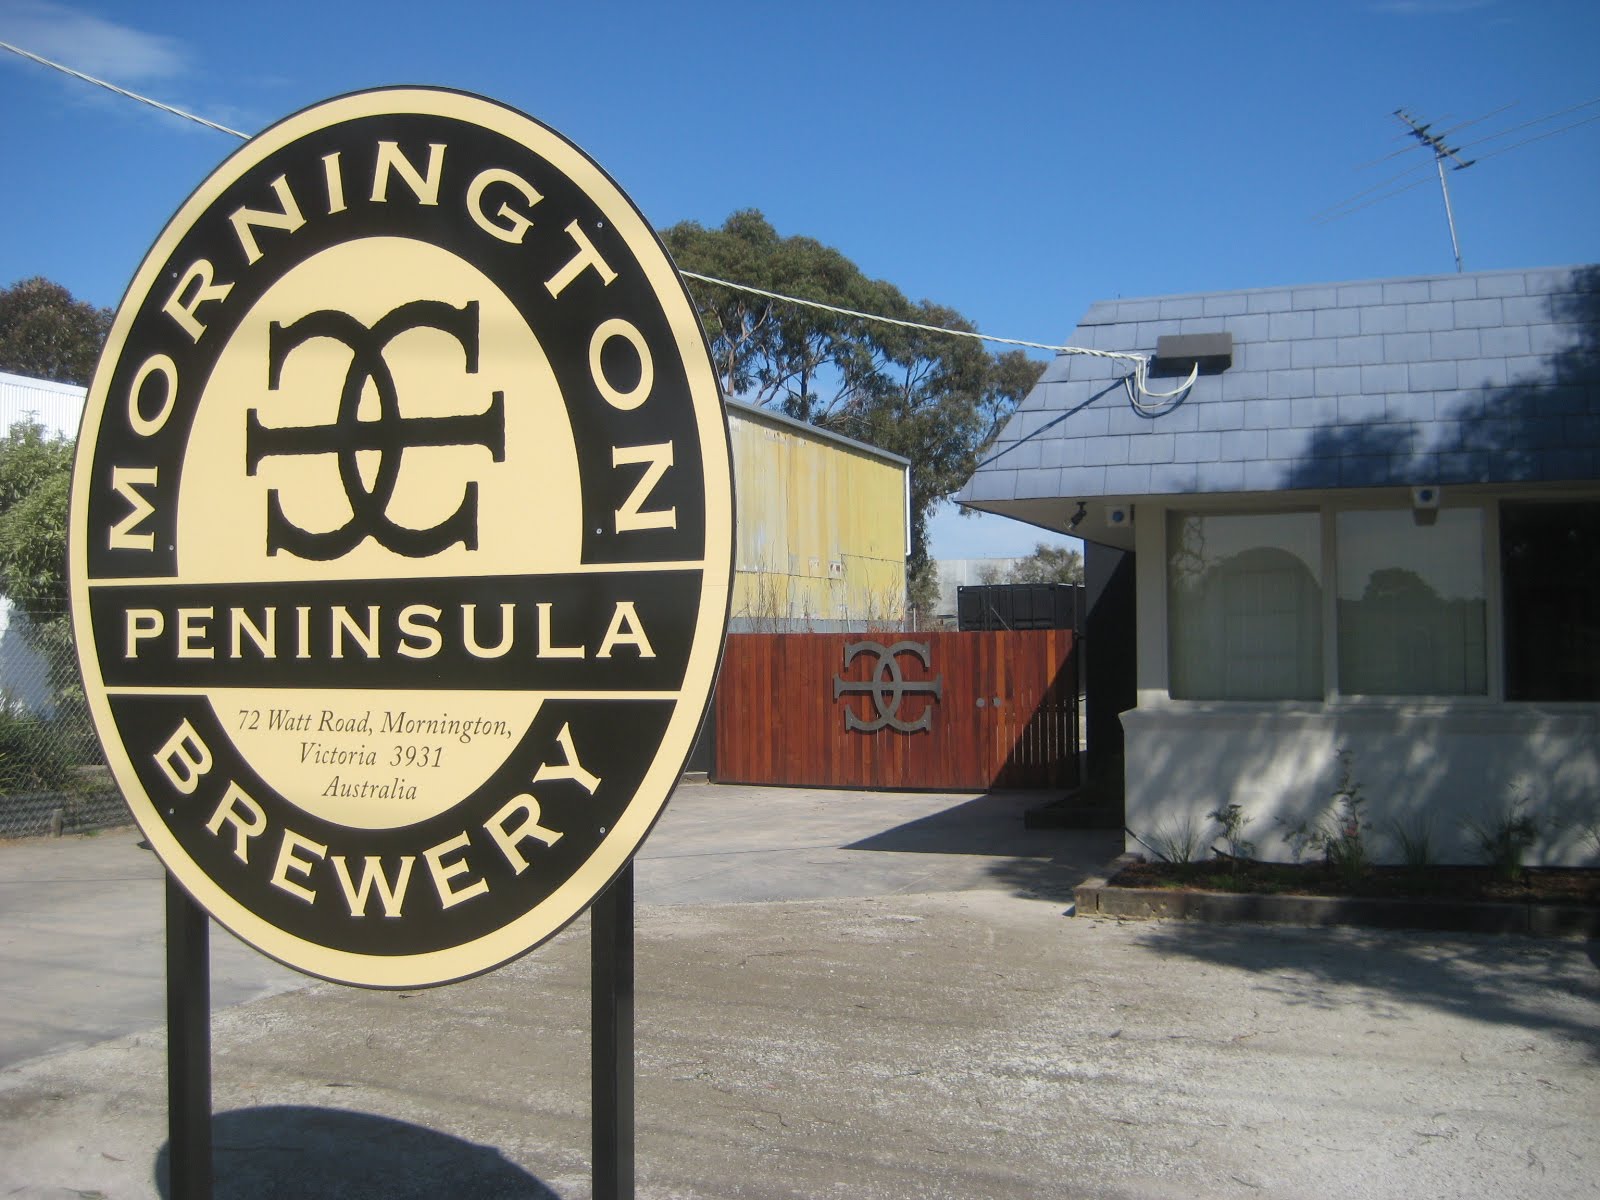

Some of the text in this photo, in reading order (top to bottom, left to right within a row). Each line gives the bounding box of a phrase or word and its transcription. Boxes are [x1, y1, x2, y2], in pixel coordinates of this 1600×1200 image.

[108, 140, 678, 553] MORNINGTON
[124, 601, 658, 660] PENINSULA
[238, 708, 512, 744] 72 Watt Road, Mornington,
[300, 741, 443, 768] Victoria 3931
[321, 775, 417, 800] Australia
[152, 717, 602, 918] BREWERY
